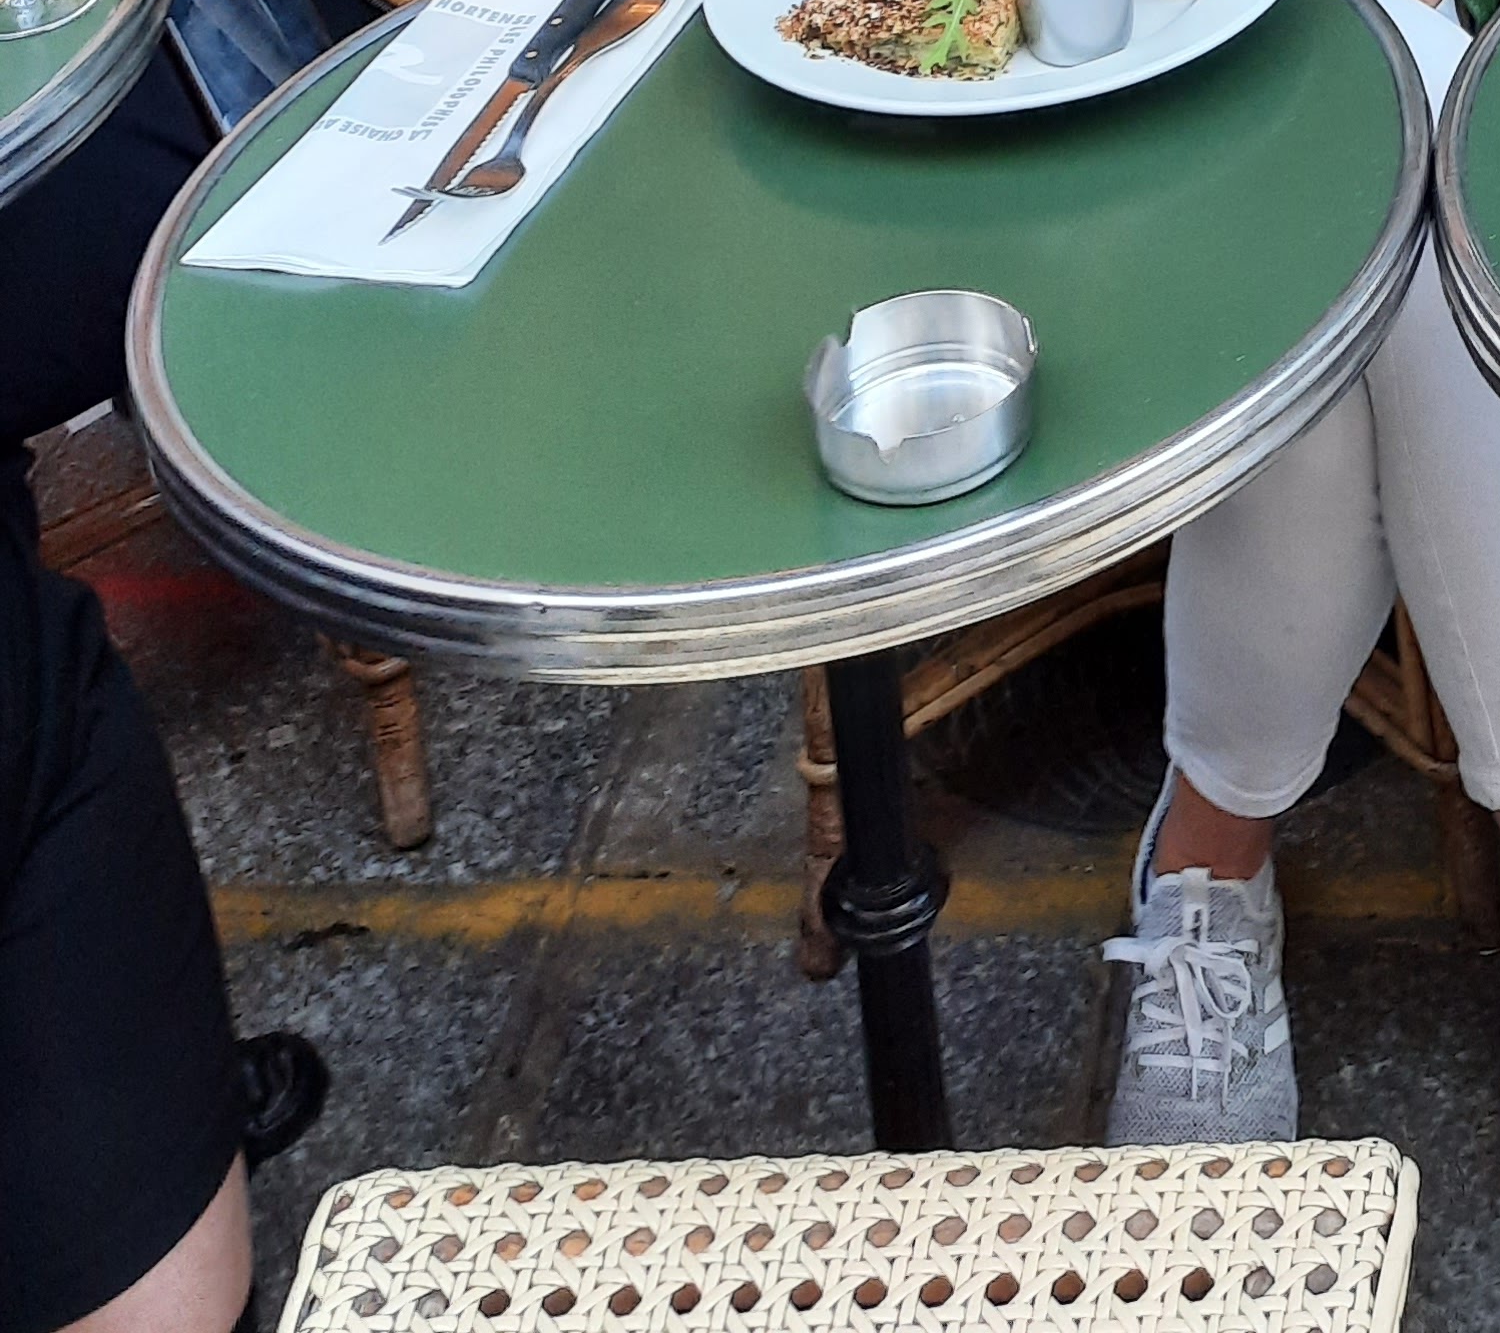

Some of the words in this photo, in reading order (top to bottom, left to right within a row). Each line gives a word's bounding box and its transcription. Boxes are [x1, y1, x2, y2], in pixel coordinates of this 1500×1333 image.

[420, 48, 507, 128] PHILOSOPHES
[338, 120, 405, 142] CHAISE
[407, 128, 433, 142] LA
